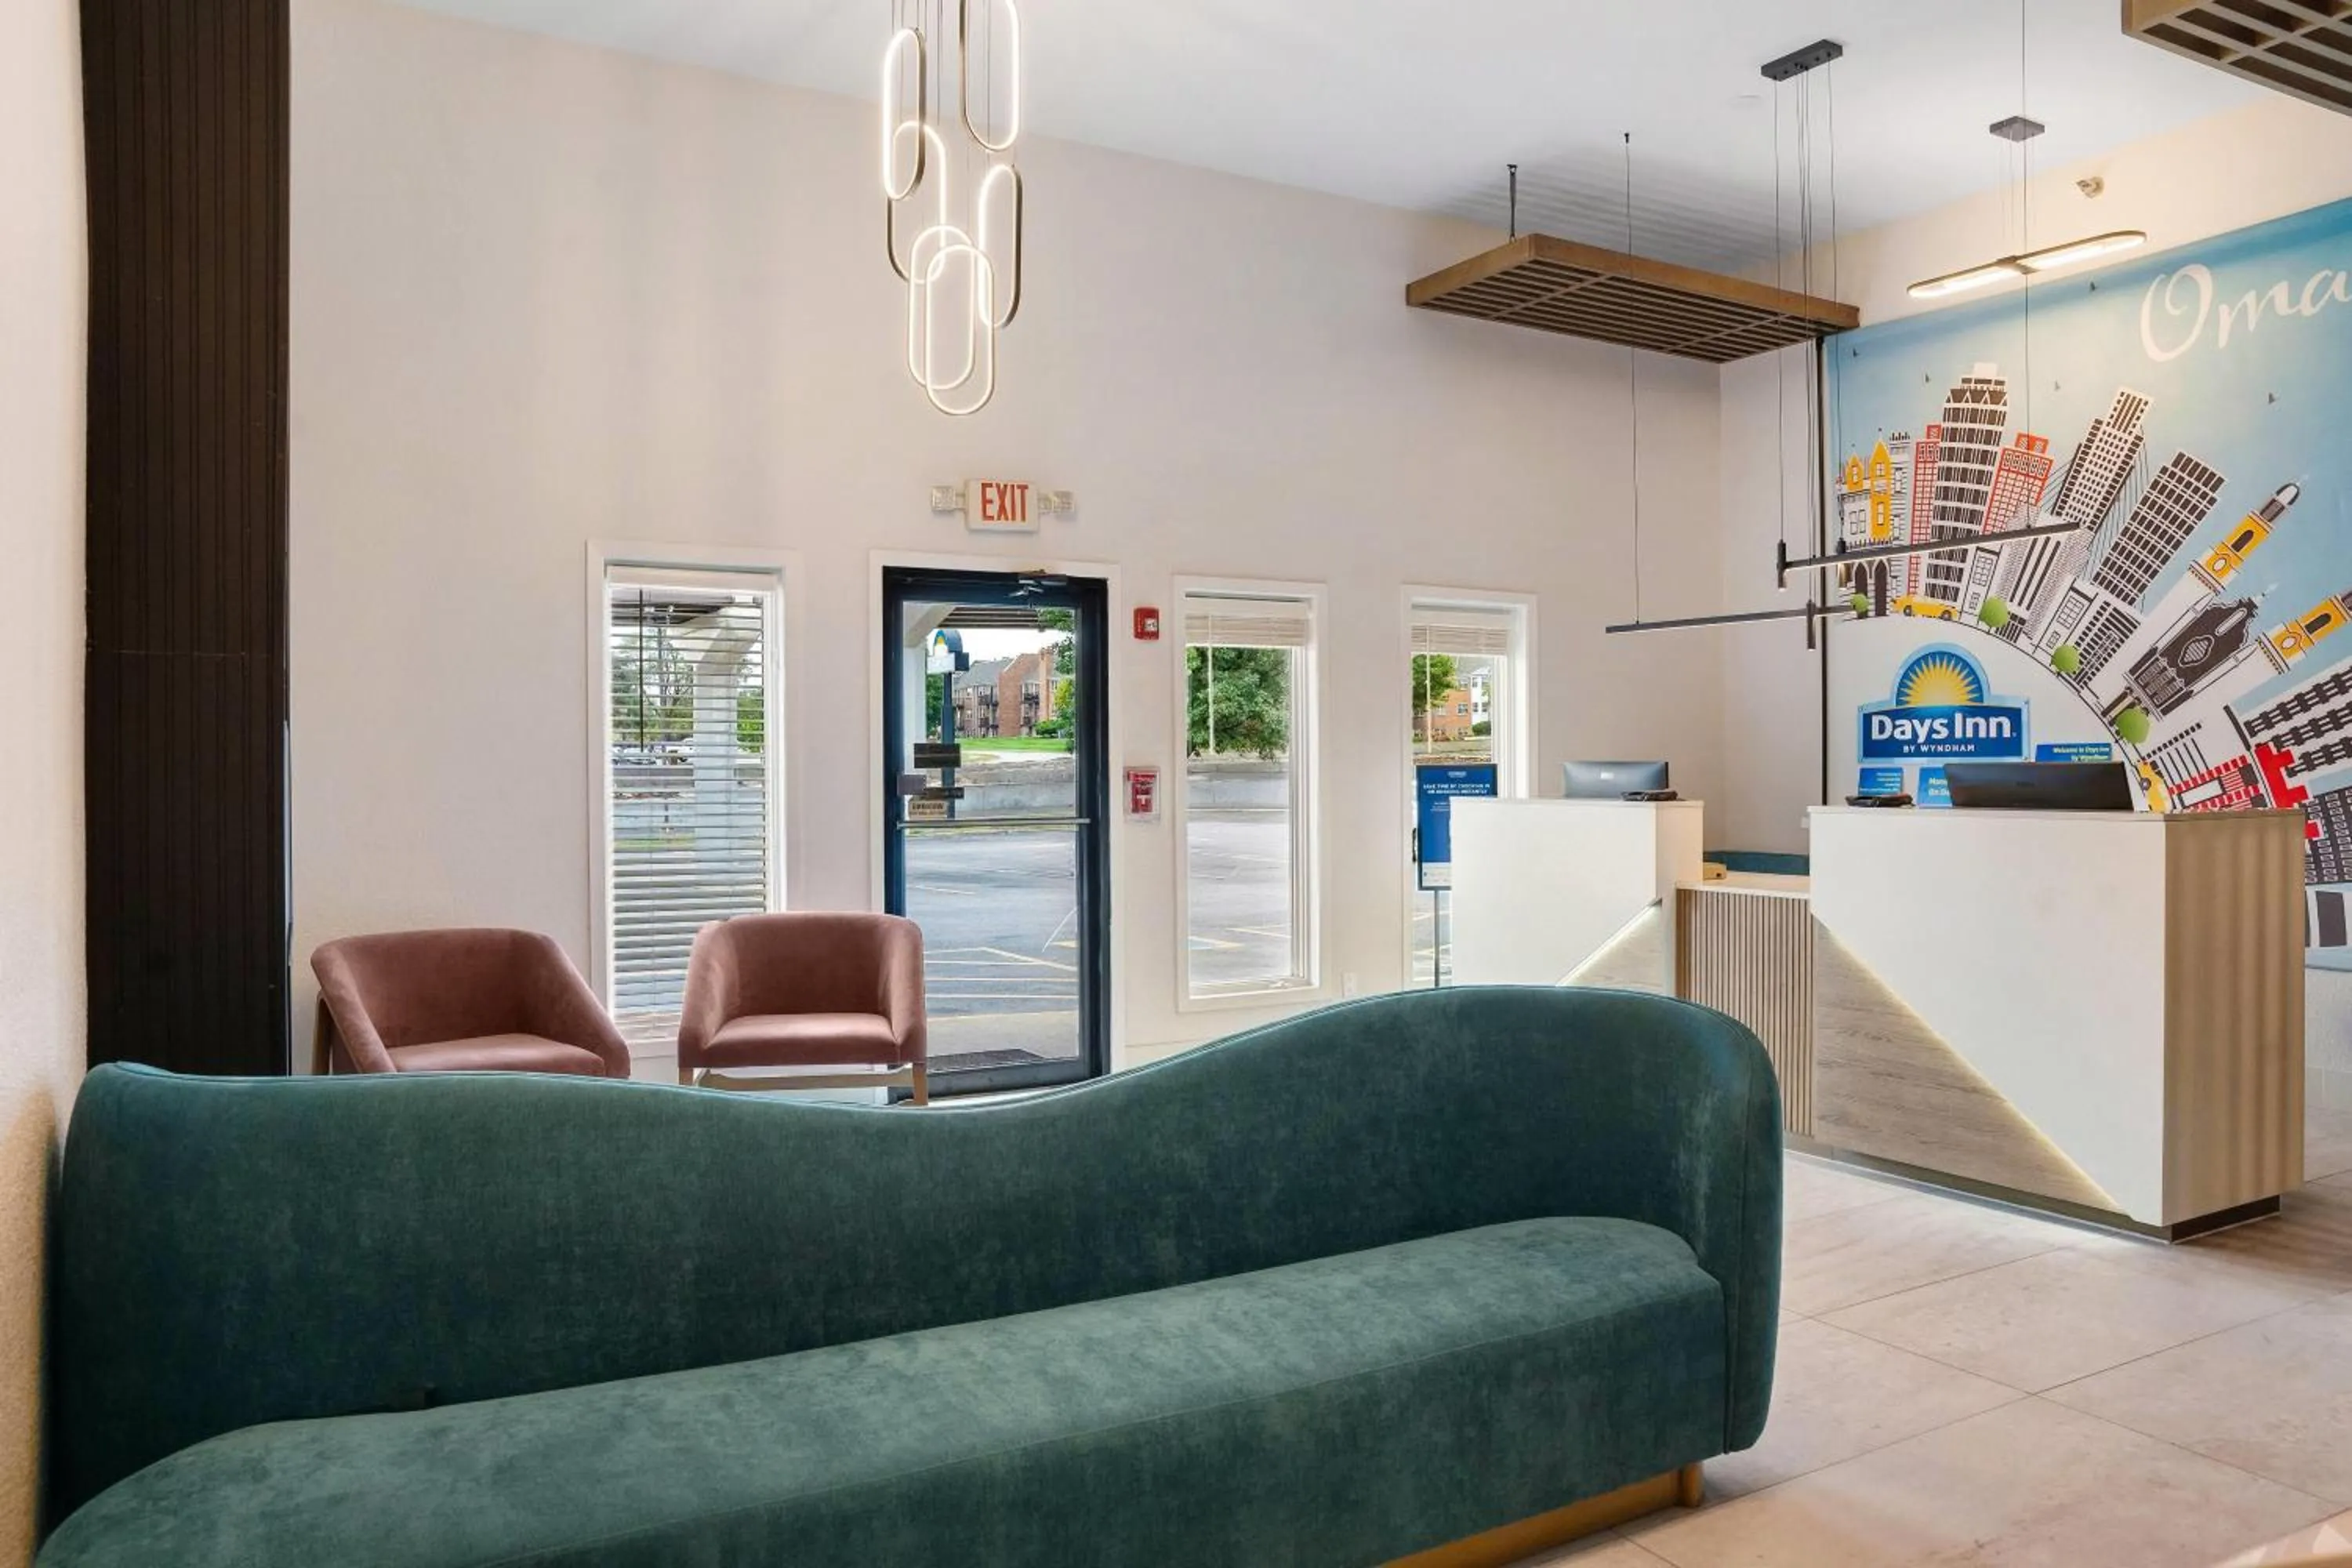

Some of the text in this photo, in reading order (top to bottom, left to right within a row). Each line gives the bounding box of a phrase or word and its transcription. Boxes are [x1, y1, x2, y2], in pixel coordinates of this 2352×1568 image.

[981, 482, 1029, 523] EXIT
[1871, 712, 2012, 744] Days Inn
[1903, 744, 1976, 753] BY WYNDHAM
